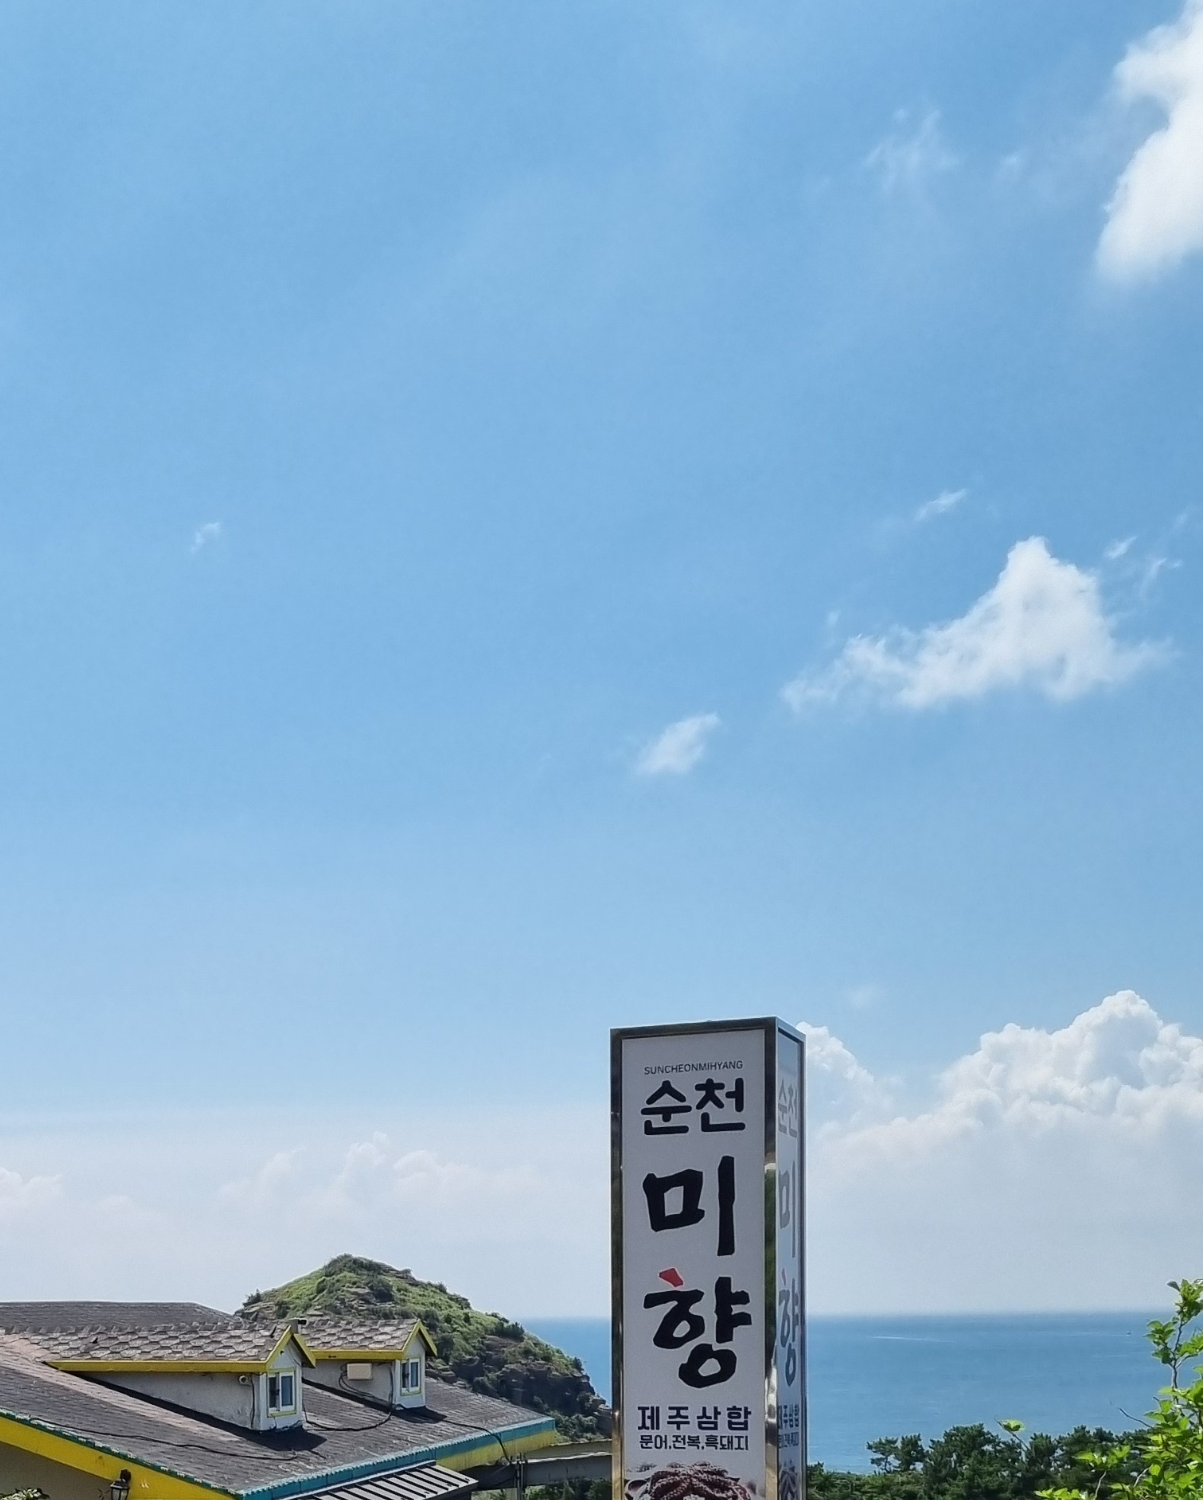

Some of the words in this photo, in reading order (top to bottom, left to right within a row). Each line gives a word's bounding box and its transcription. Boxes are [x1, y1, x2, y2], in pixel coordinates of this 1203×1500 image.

[644, 1060, 744, 1075] SUNCHEONMIHYANG
[641, 1077, 746, 1136] 순천
[642, 1155, 752, 1389] 미향
[637, 1405, 752, 1431] 제주삼합
